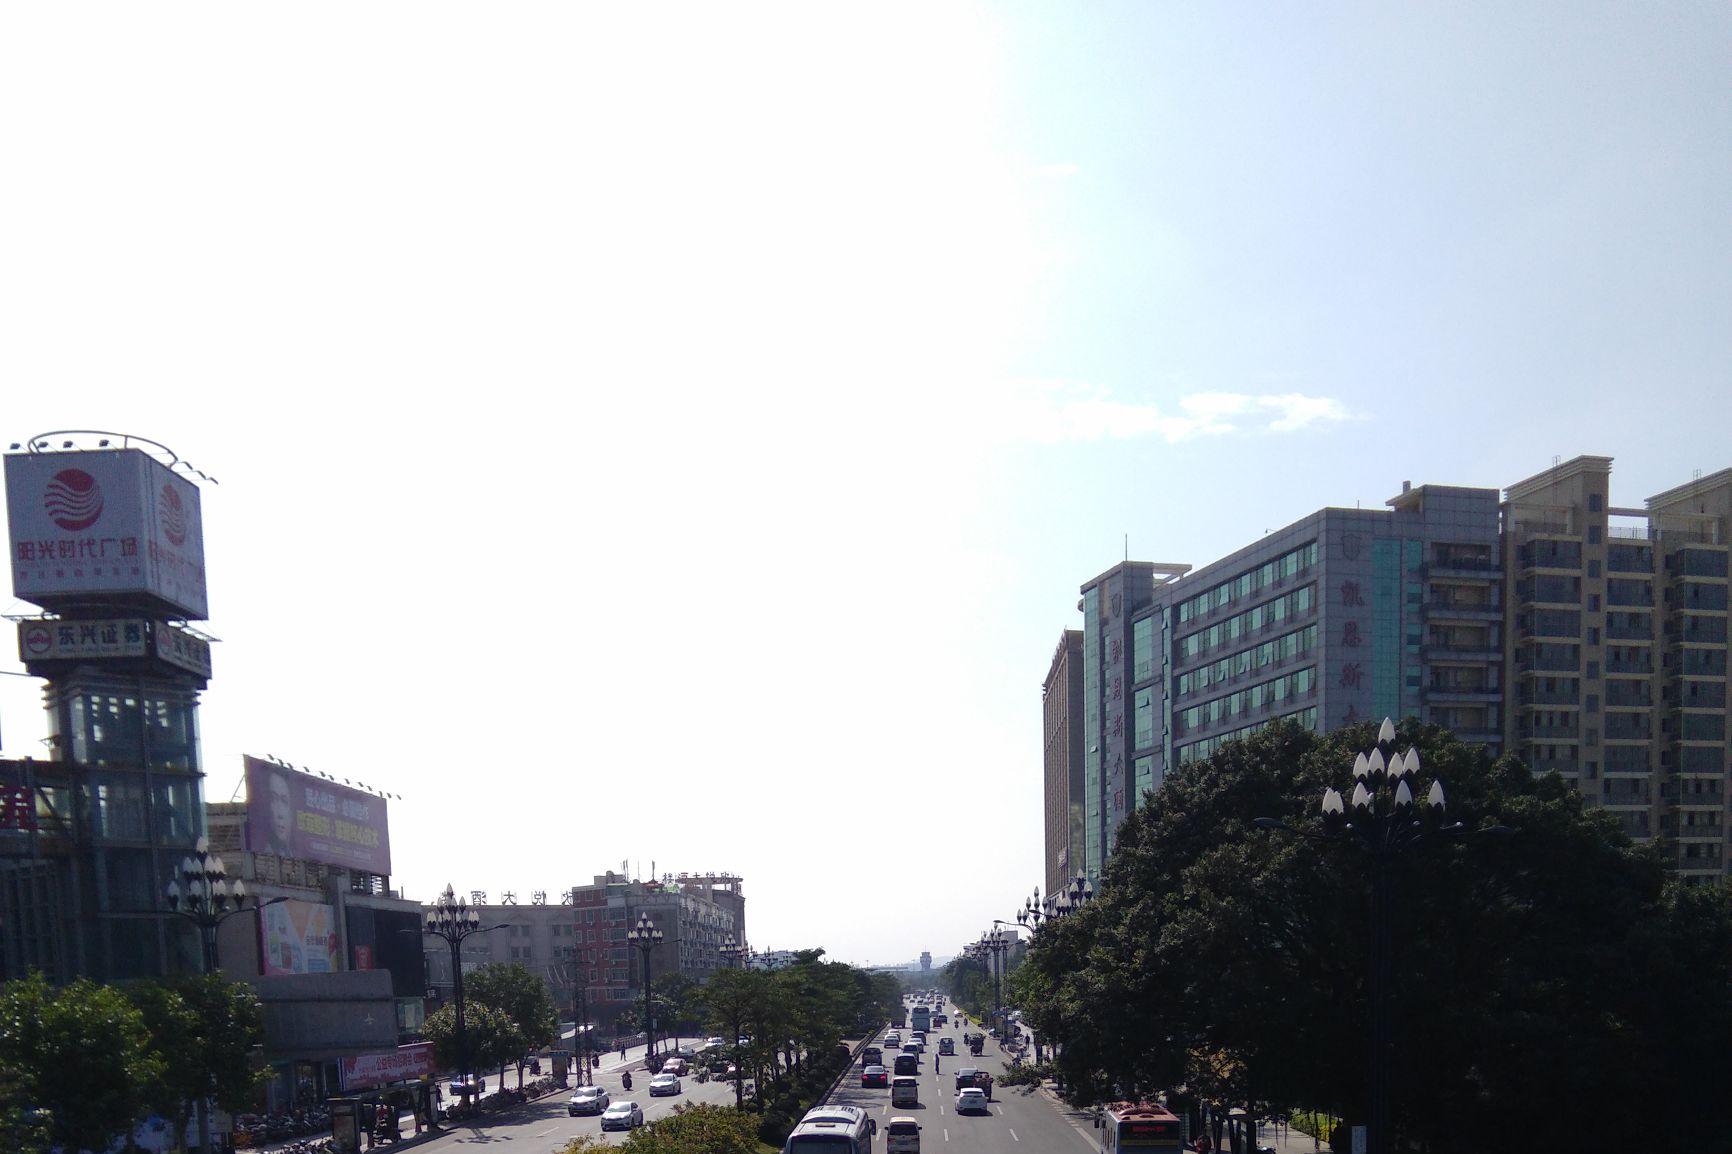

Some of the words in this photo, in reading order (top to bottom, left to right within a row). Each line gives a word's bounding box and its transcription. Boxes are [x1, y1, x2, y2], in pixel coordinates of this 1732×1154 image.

[18, 538, 138, 560] 阳光时代广场
[58, 623, 140, 646] 东兴证券
